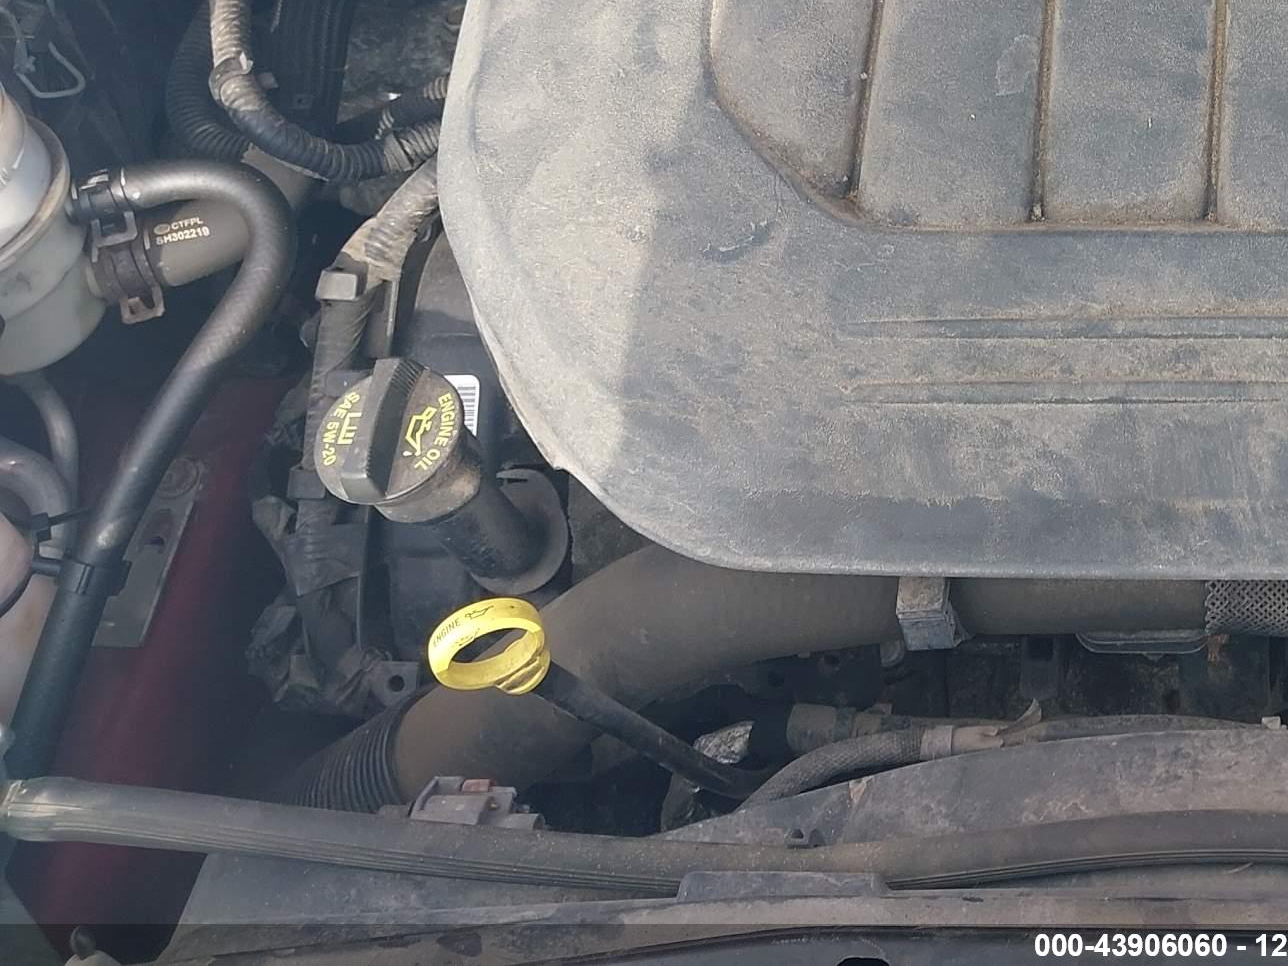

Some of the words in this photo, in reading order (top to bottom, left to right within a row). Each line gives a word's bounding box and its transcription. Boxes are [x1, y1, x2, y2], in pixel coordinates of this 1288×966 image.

[334, 391, 361, 419] SAE
[434, 392, 455, 447] ENGINE
[322, 421, 339, 466] 5W-20
[414, 448, 440, 471] OIL
[433, 617, 461, 648] ENGINE
